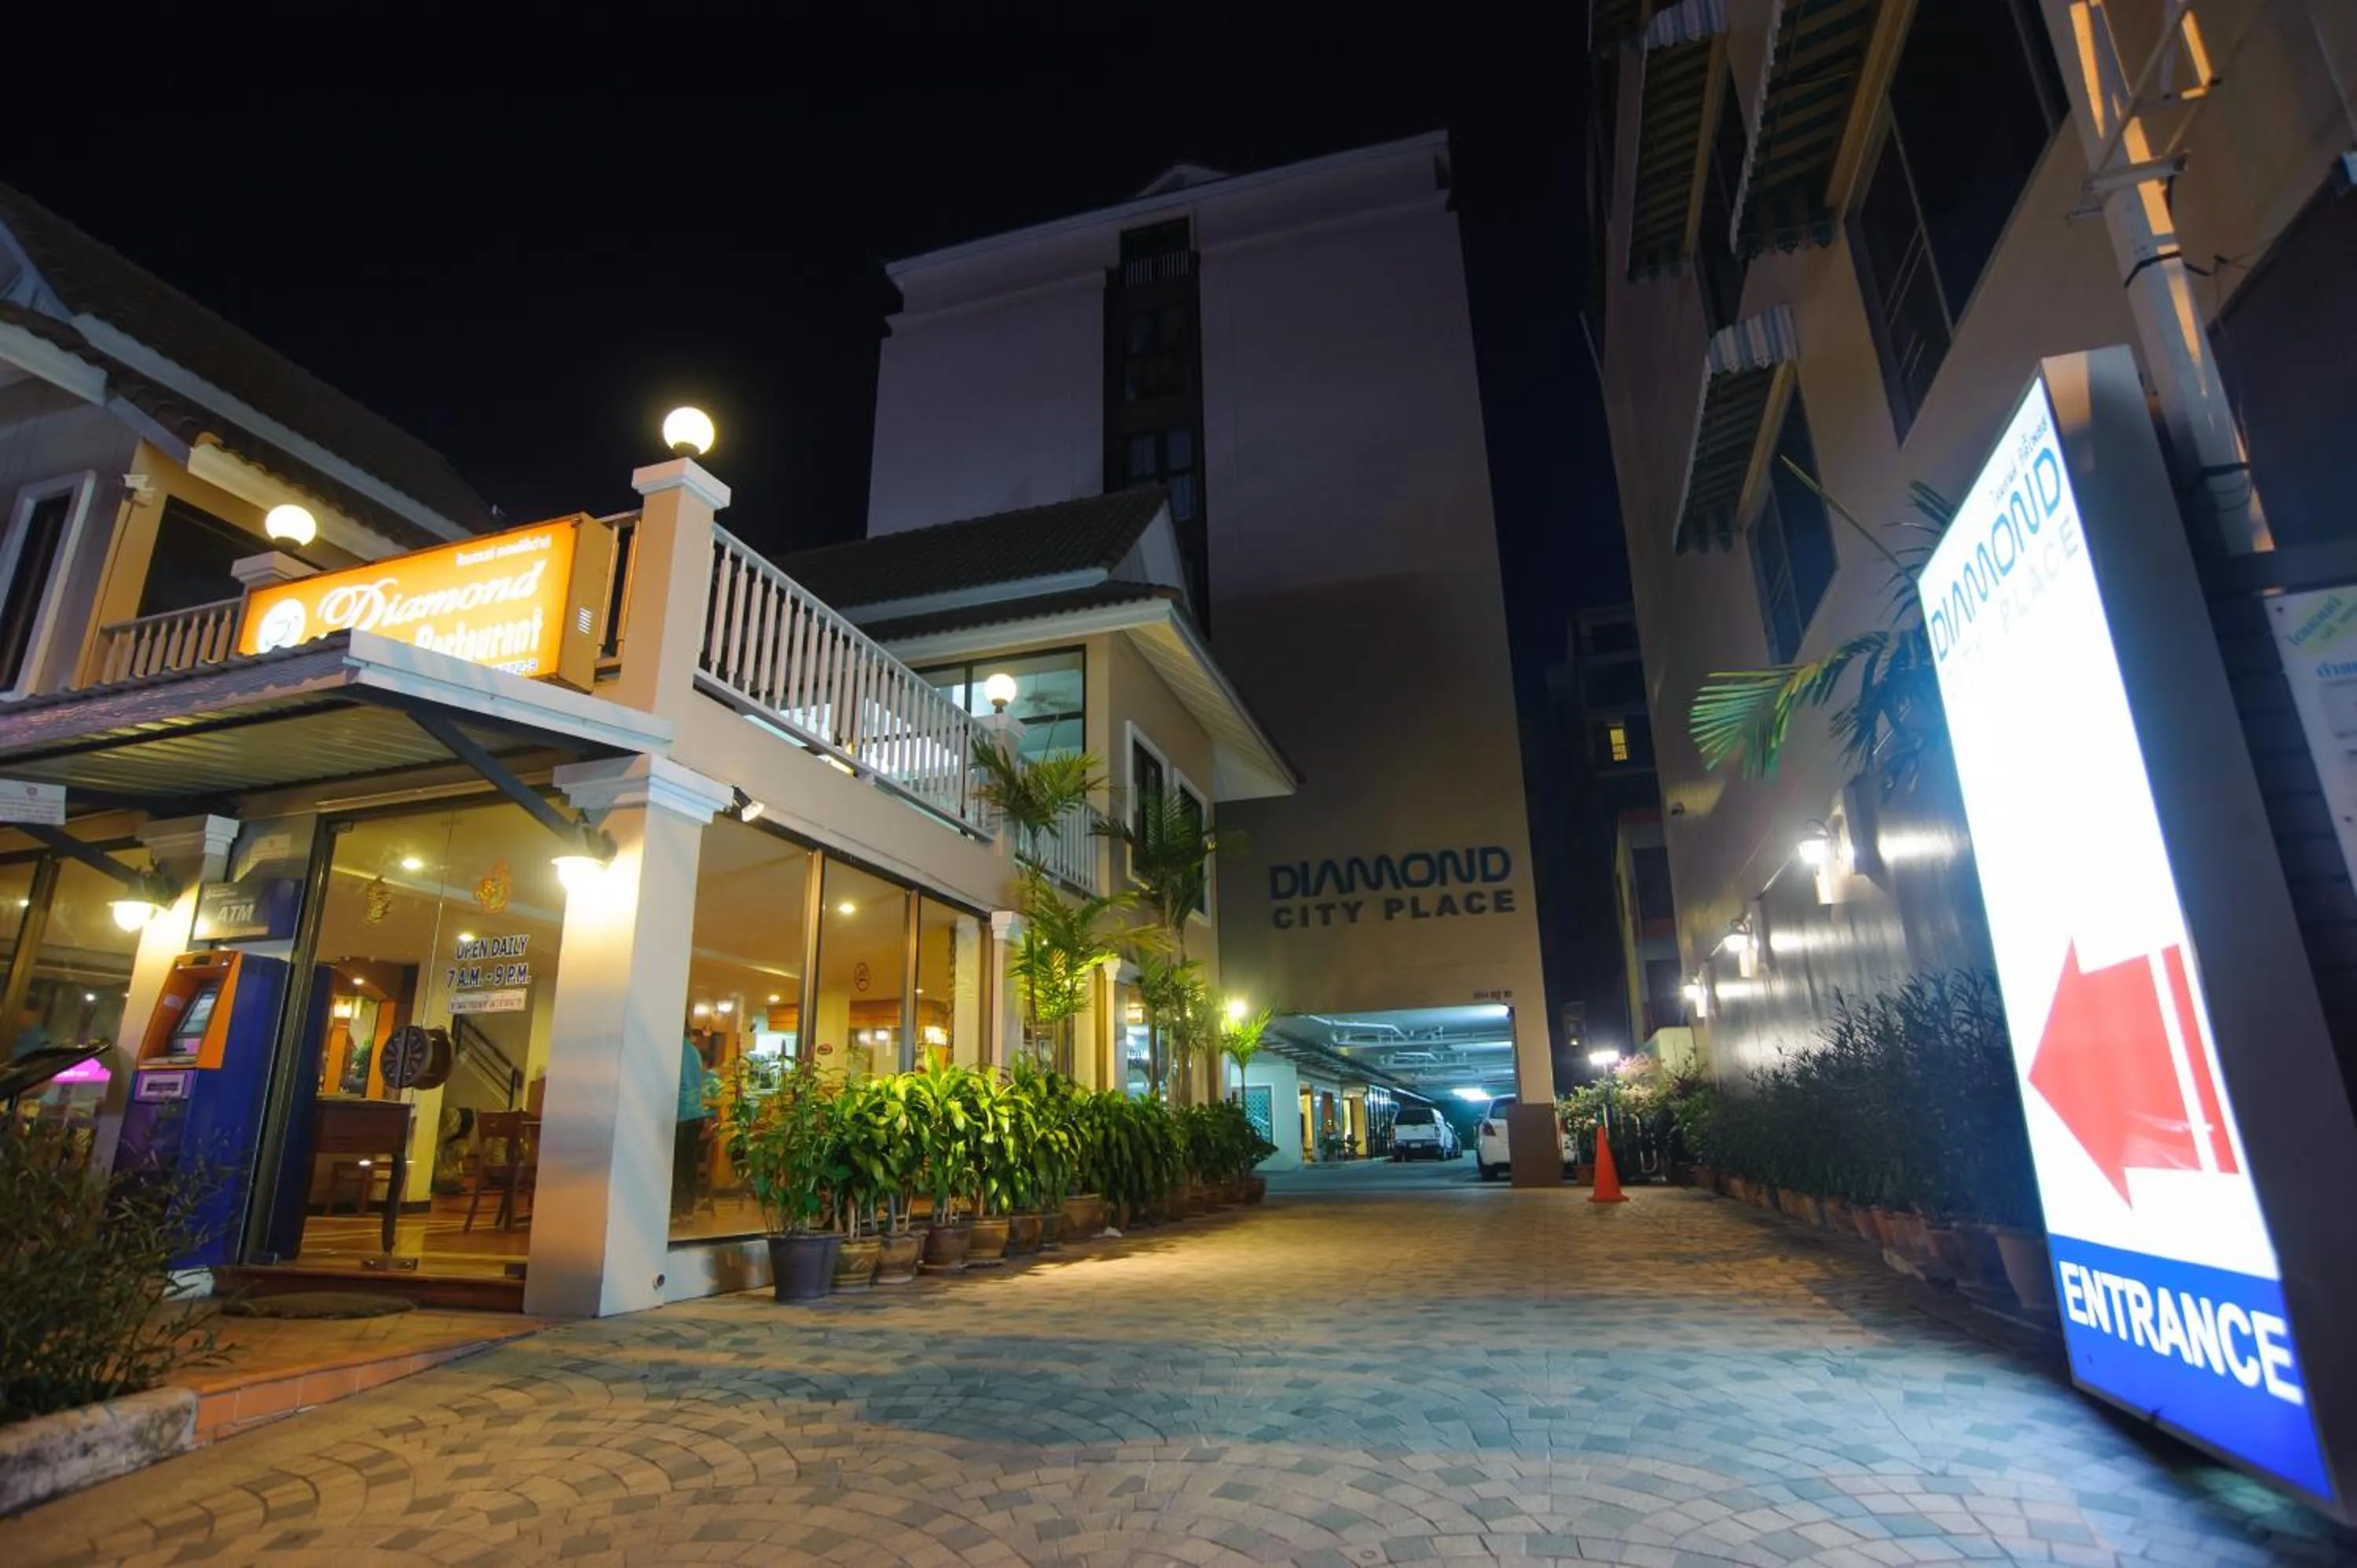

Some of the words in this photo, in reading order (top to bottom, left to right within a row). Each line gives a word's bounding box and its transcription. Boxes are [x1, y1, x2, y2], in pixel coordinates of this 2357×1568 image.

[1930, 446, 2062, 663] DIAMOND
[317, 559, 548, 631] Diamond
[1269, 845, 1512, 901] DIAMOND
[218, 903, 255, 922] ATM
[1271, 900, 1364, 930] CITY
[1384, 889, 1516, 921] PLACE
[455, 938, 488, 959] OPEN
[489, 934, 530, 958] DAILY
[447, 968, 456, 988] 7
[494, 965, 504, 985] 9
[2058, 1259, 2304, 1407] ENTRANCE
